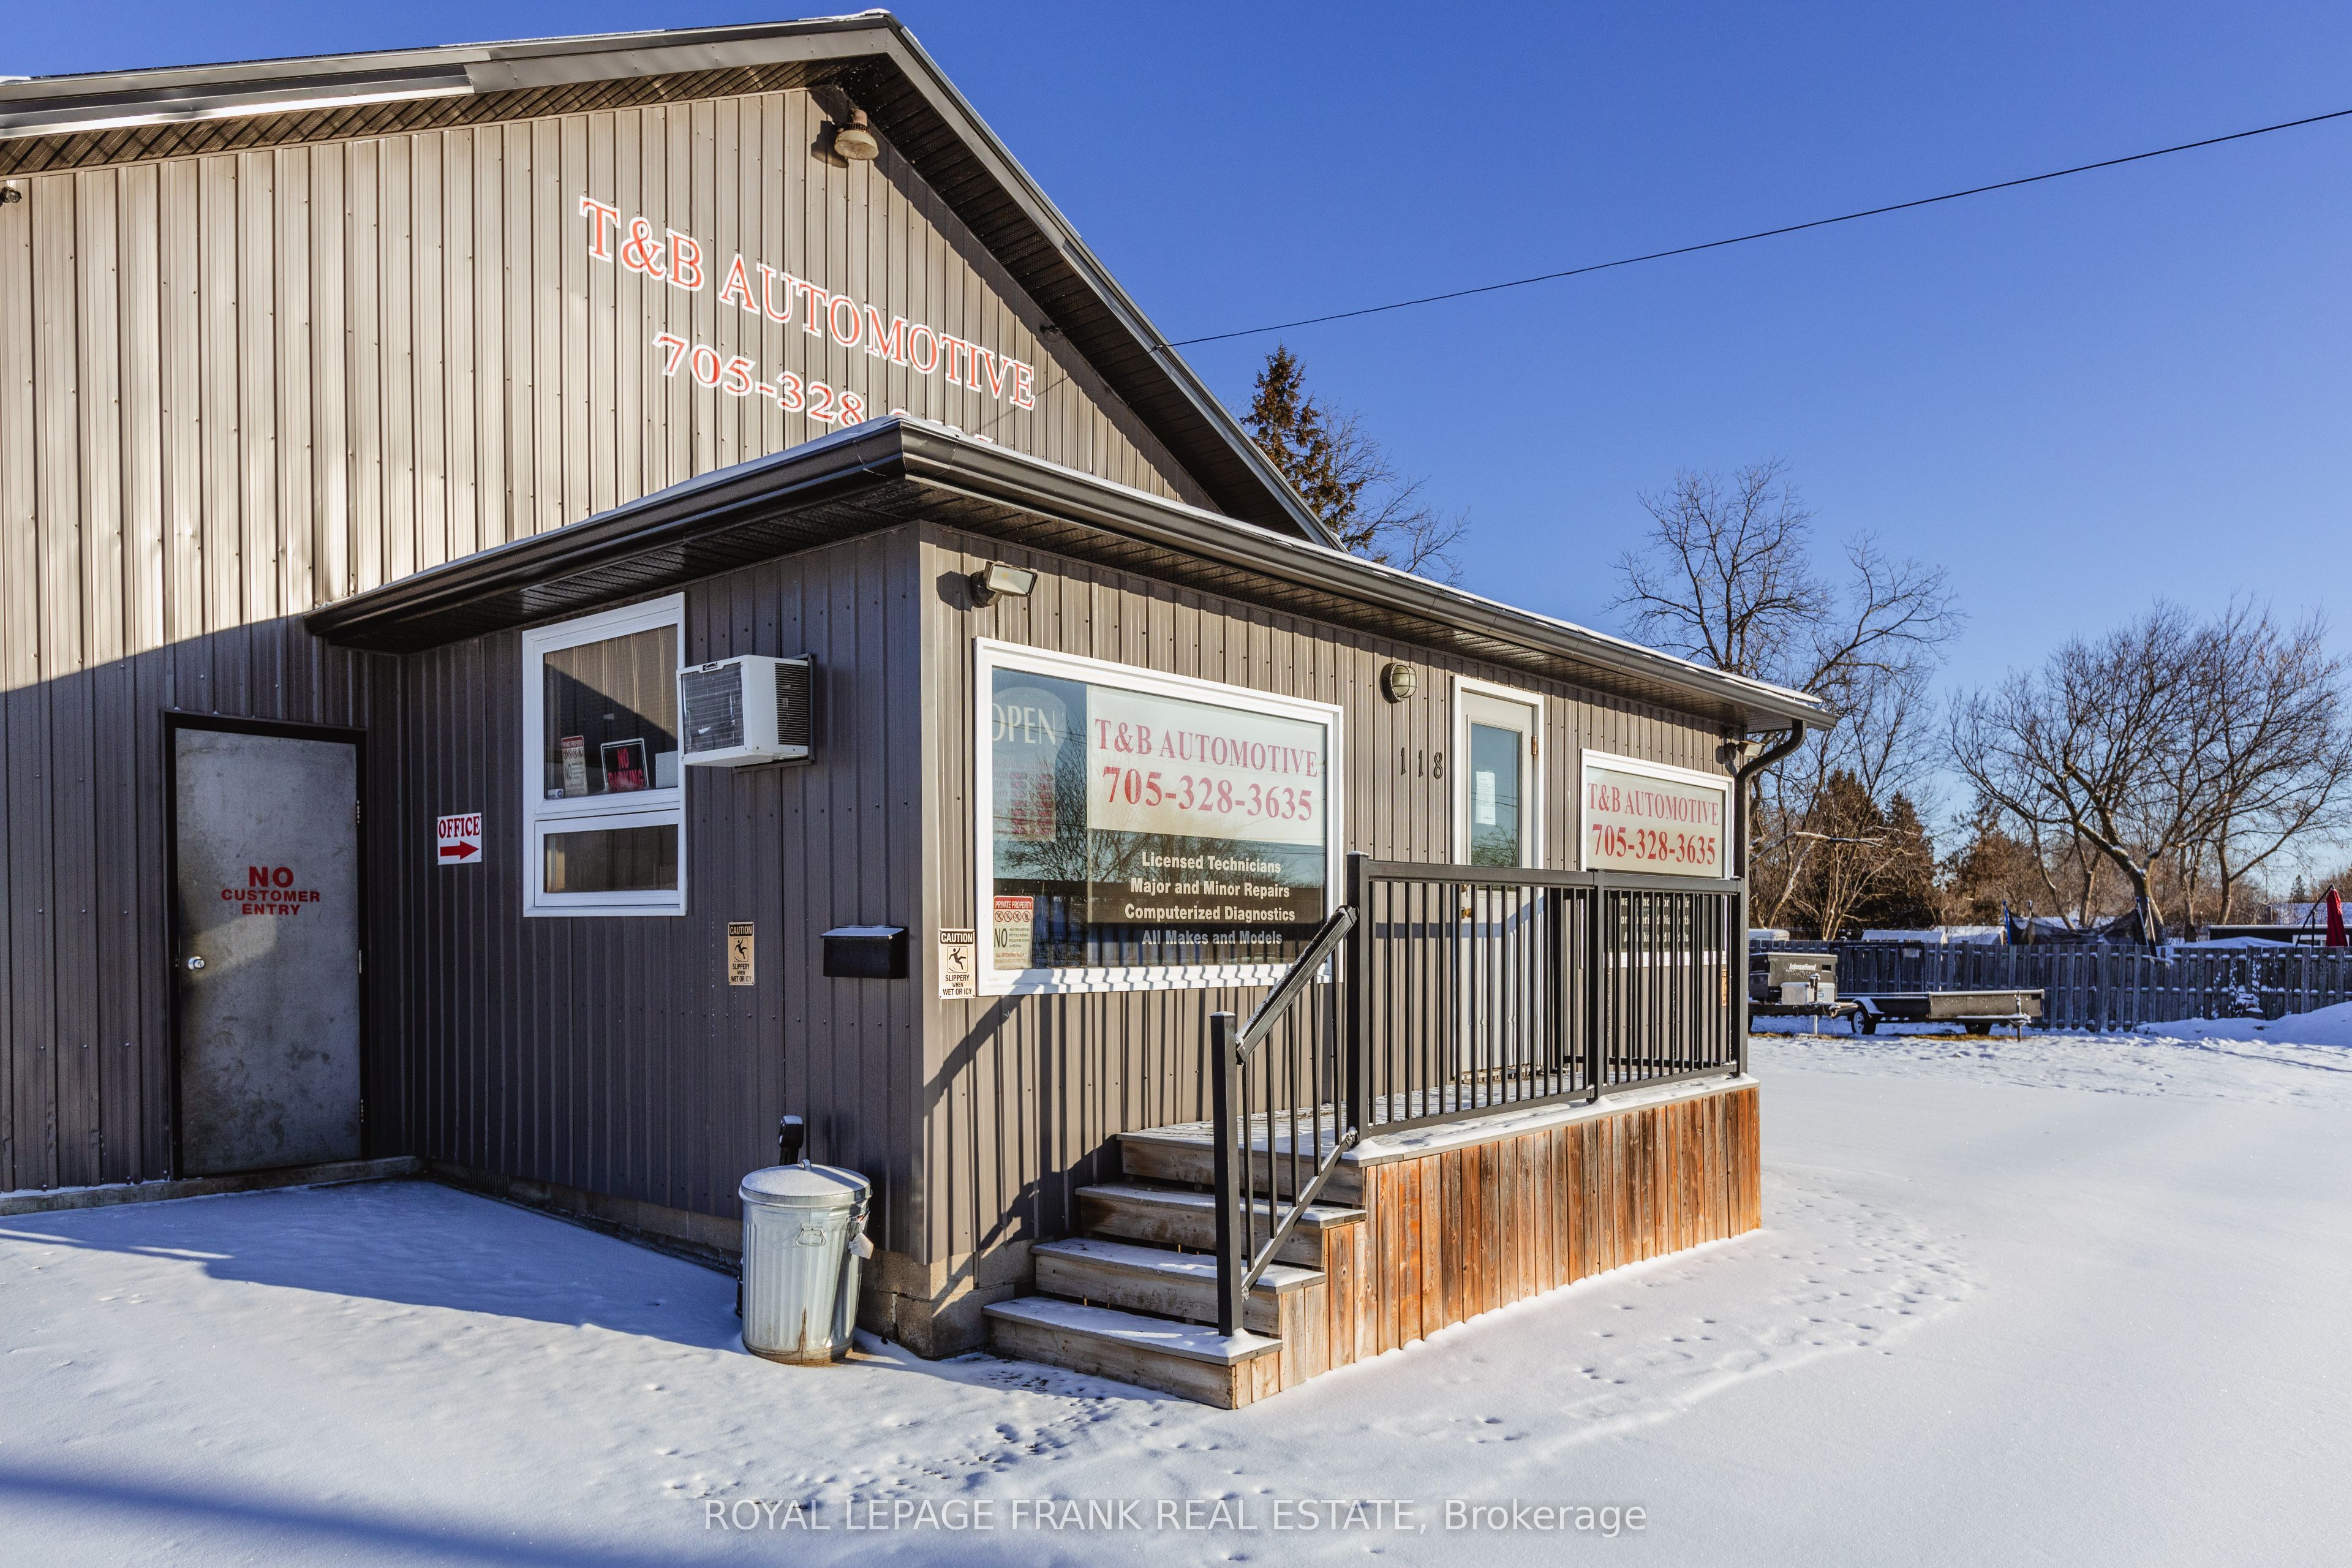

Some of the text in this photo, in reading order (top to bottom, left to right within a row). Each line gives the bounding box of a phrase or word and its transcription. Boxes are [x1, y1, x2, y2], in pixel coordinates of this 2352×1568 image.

[579, 196, 1036, 410] T&B AUTOMOTIVE
[1095, 718, 1317, 777] T&B AUTOMOTIVE
[617, 748, 629, 769] NO
[1401, 747, 1443, 780] 118
[564, 764, 572, 780] NO
[1103, 766, 1312, 821] 705-328-3635
[1588, 783, 1719, 826] T&B AUTOMOTIVE
[439, 815, 480, 839] OFFICE
[1592, 824, 1715, 865] 705-328-3635
[1142, 851, 1281, 873] Licensed Technicians
[249, 866, 294, 888] NO
[221, 889, 320, 902] CUSTOMER
[1131, 878, 1290, 899] Major and Minor Repairs
[241, 903, 301, 915] ENTRY
[1125, 903, 1295, 923] Computerized Diagnostics
[729, 925, 752, 935] CAUTION
[941, 932, 973, 943] CAUTION
[993, 928, 1008, 948] NO
[1142, 930, 1283, 945] All Makes and Models
[1789, 963, 1817, 971] International
